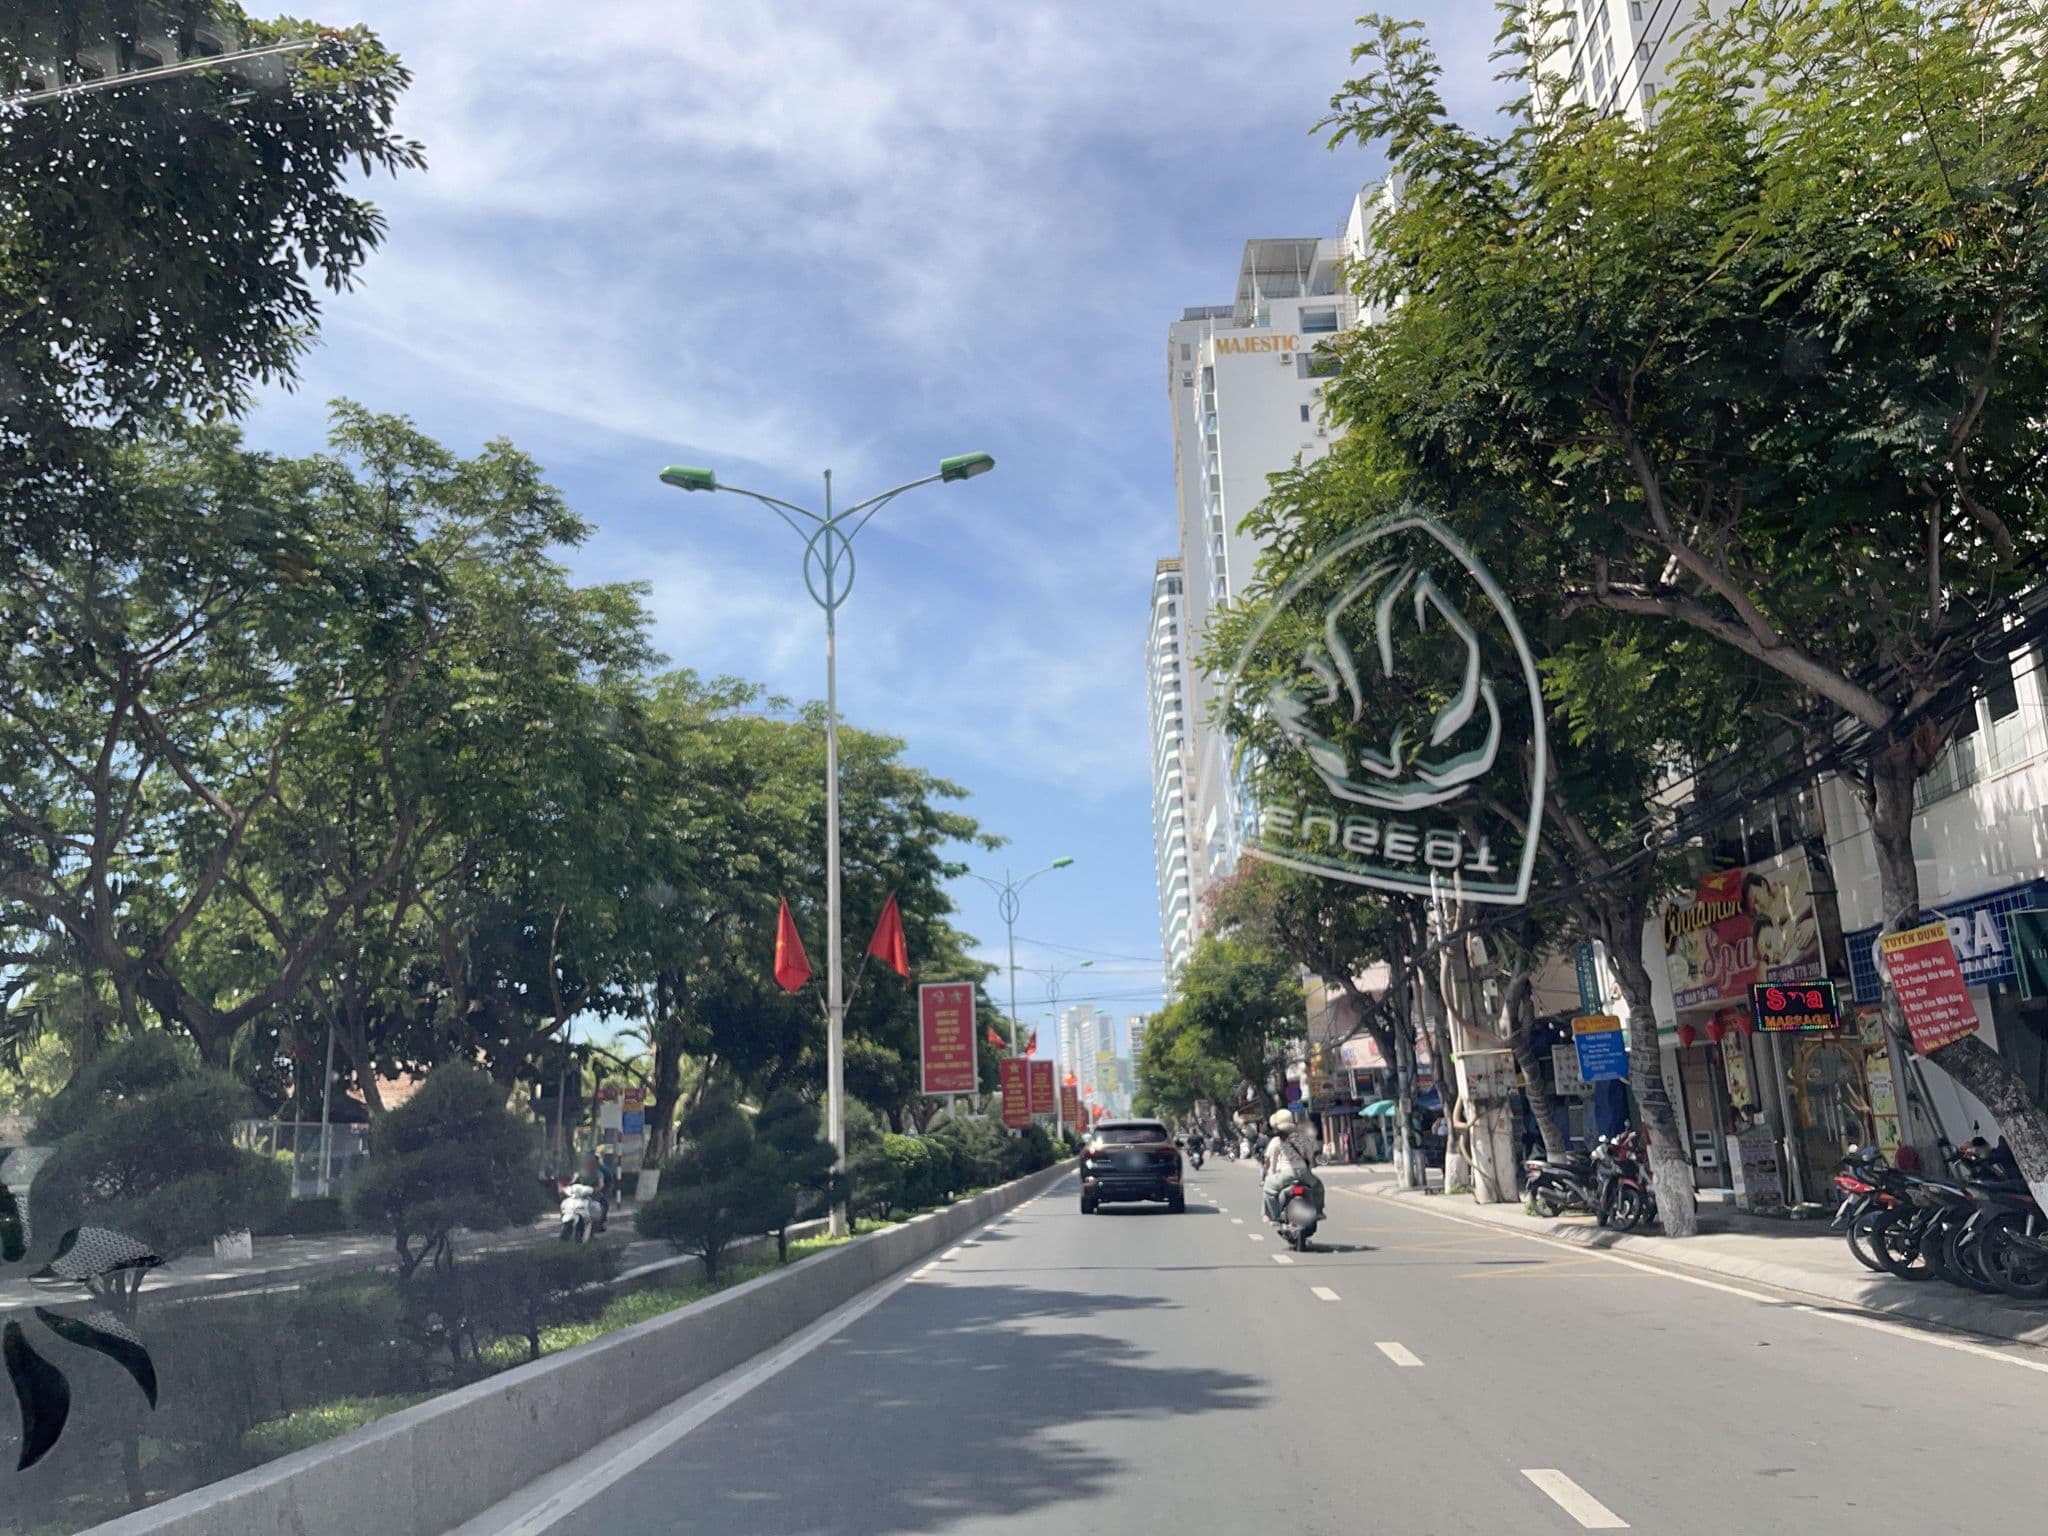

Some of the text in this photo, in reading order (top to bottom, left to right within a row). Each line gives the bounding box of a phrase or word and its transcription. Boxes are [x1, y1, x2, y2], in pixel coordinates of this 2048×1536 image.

[1215, 334, 1300, 354] MAJESTIC
[1664, 900, 1743, 950] Cinnamon
[1703, 929, 1758, 990] Spa
